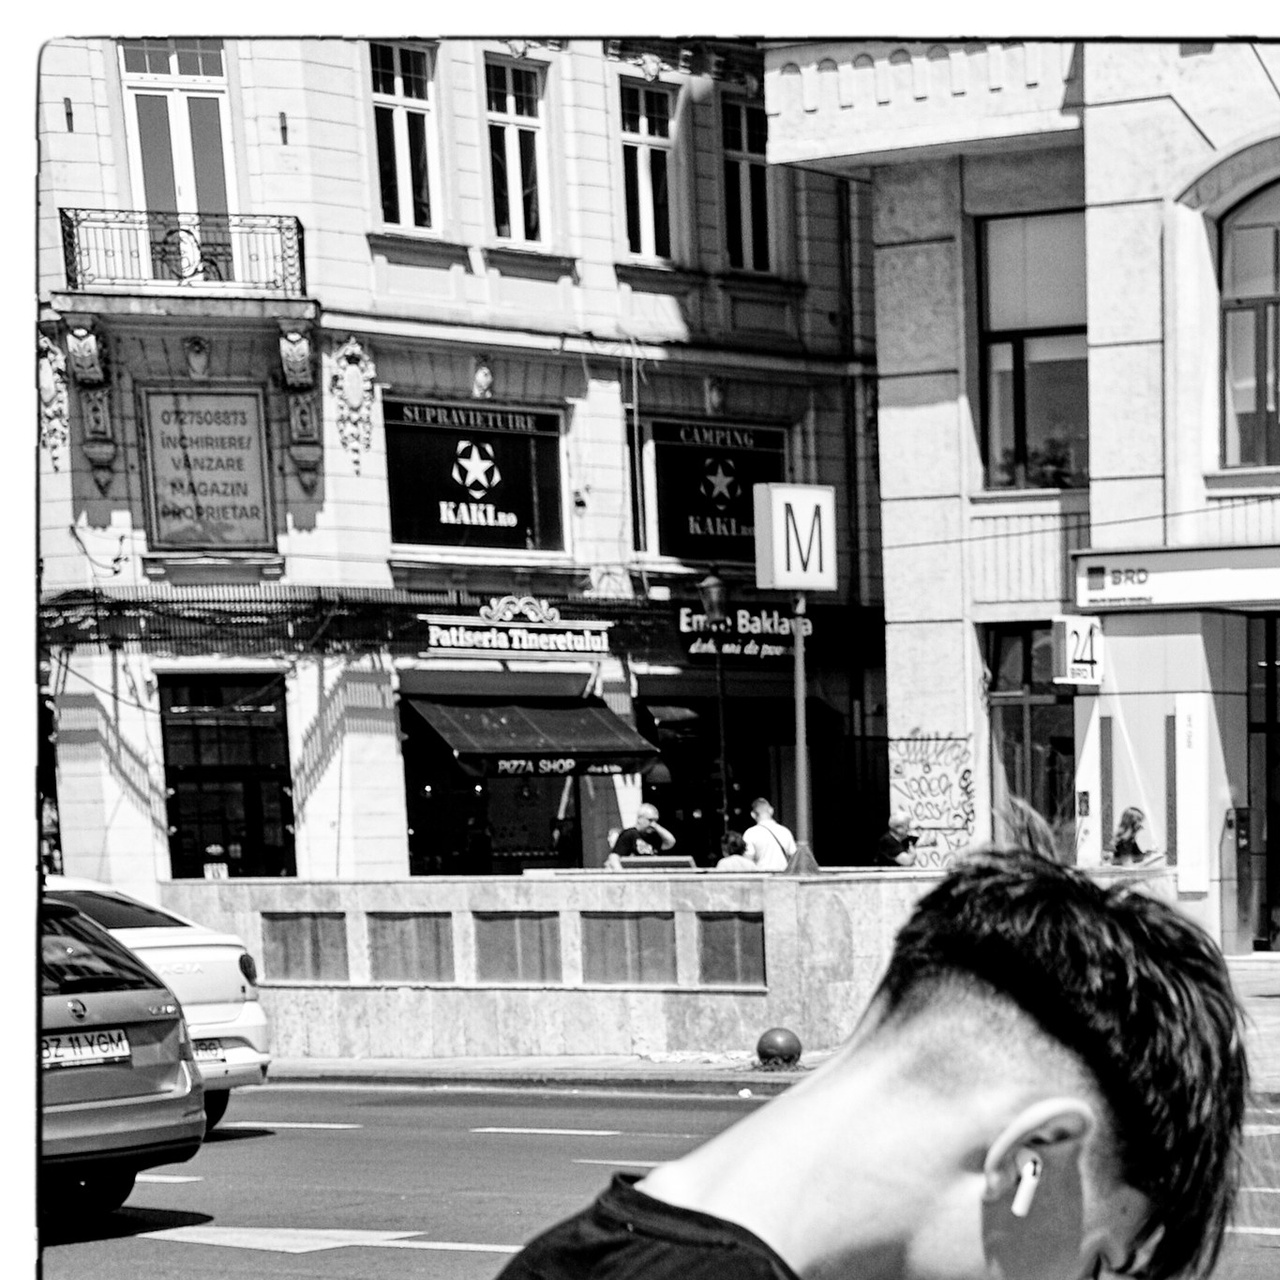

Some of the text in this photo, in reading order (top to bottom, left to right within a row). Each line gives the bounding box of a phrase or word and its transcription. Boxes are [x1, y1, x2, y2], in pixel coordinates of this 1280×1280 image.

[680, 426, 754, 448] CAMPING
[170, 481, 248, 497] MAGAZIN
[161, 504, 261, 520] PROPRIETAR
[784, 503, 823, 573] M
[1111, 568, 1148, 586] BRD
[428, 625, 610, 652] Patiseria Tineretului
[498, 759, 534, 774] PIZZA
[539, 758, 576, 774] SHOP
